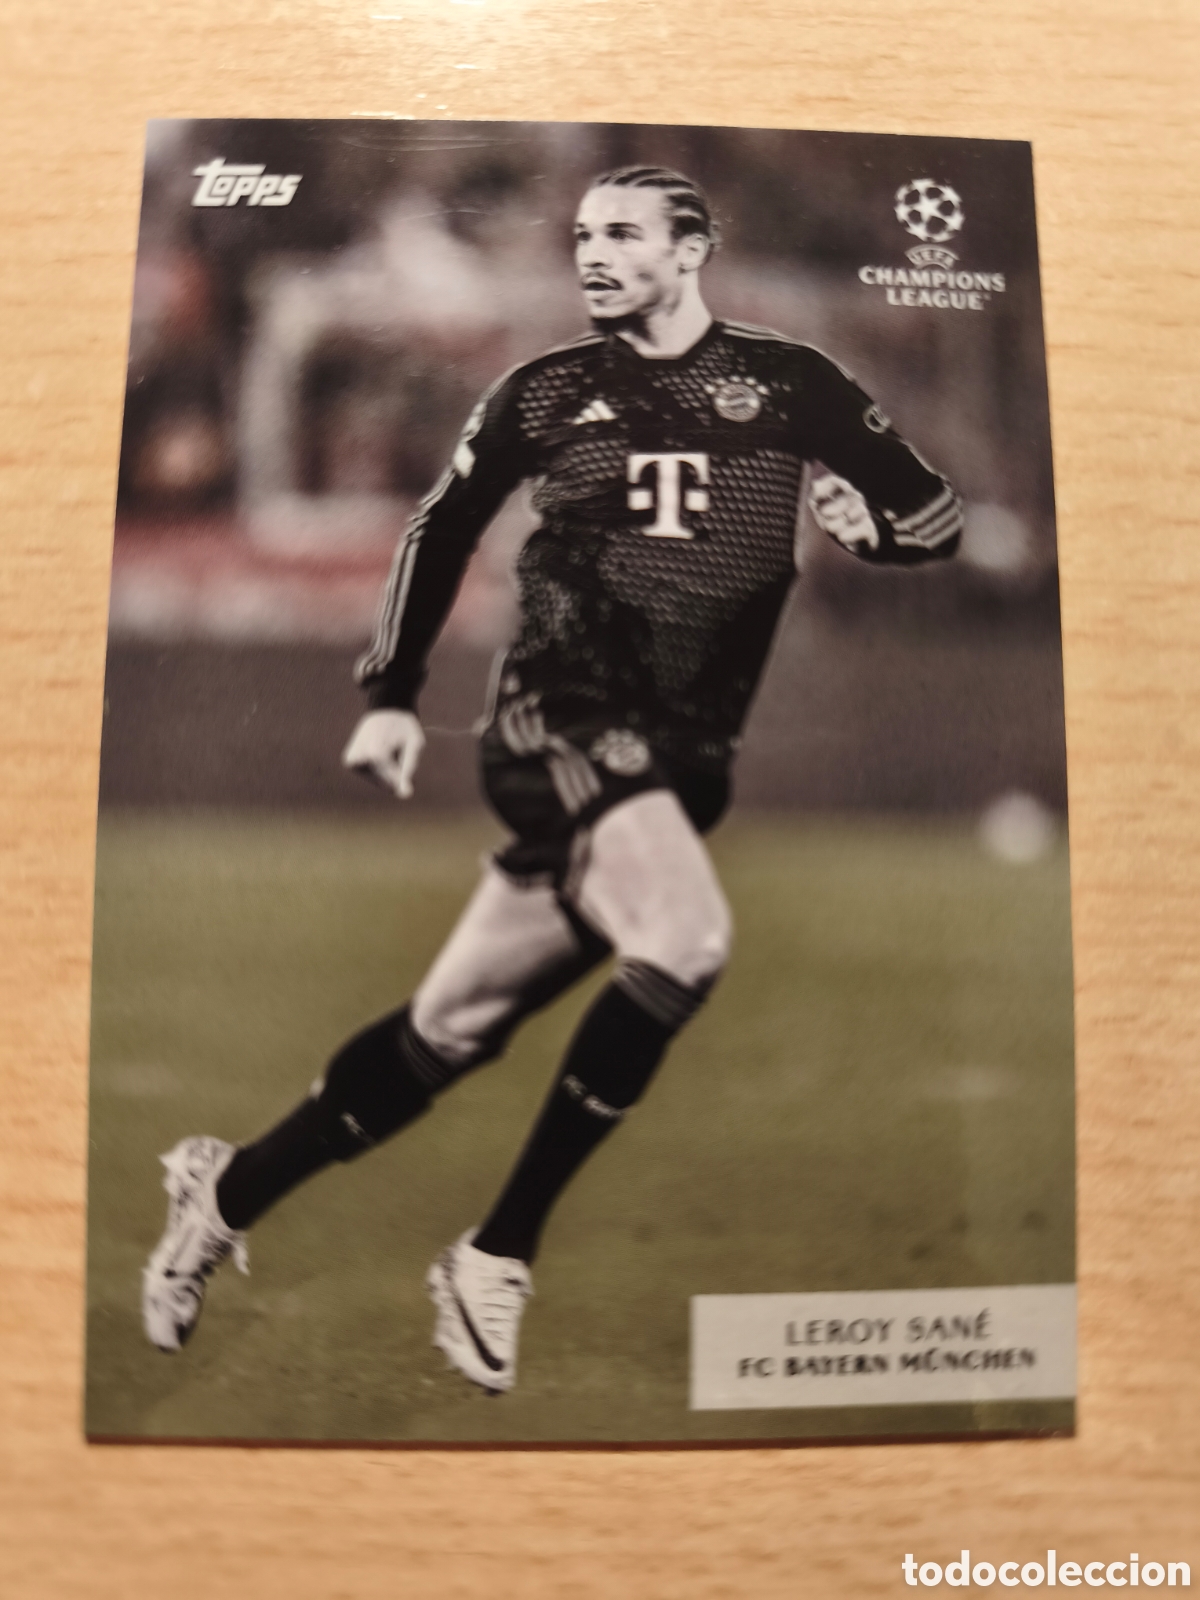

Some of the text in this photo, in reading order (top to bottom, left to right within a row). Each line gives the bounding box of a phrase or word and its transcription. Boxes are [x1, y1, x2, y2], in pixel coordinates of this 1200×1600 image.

[858, 265, 1006, 292] CHAMPIONS
[886, 287, 985, 310] LEAGUE
[627, 453, 709, 539] T
[785, 1307, 993, 1346] LEROY SANÉ
[737, 1356, 775, 1378] FC
[783, 1352, 889, 1376] BAYERN
